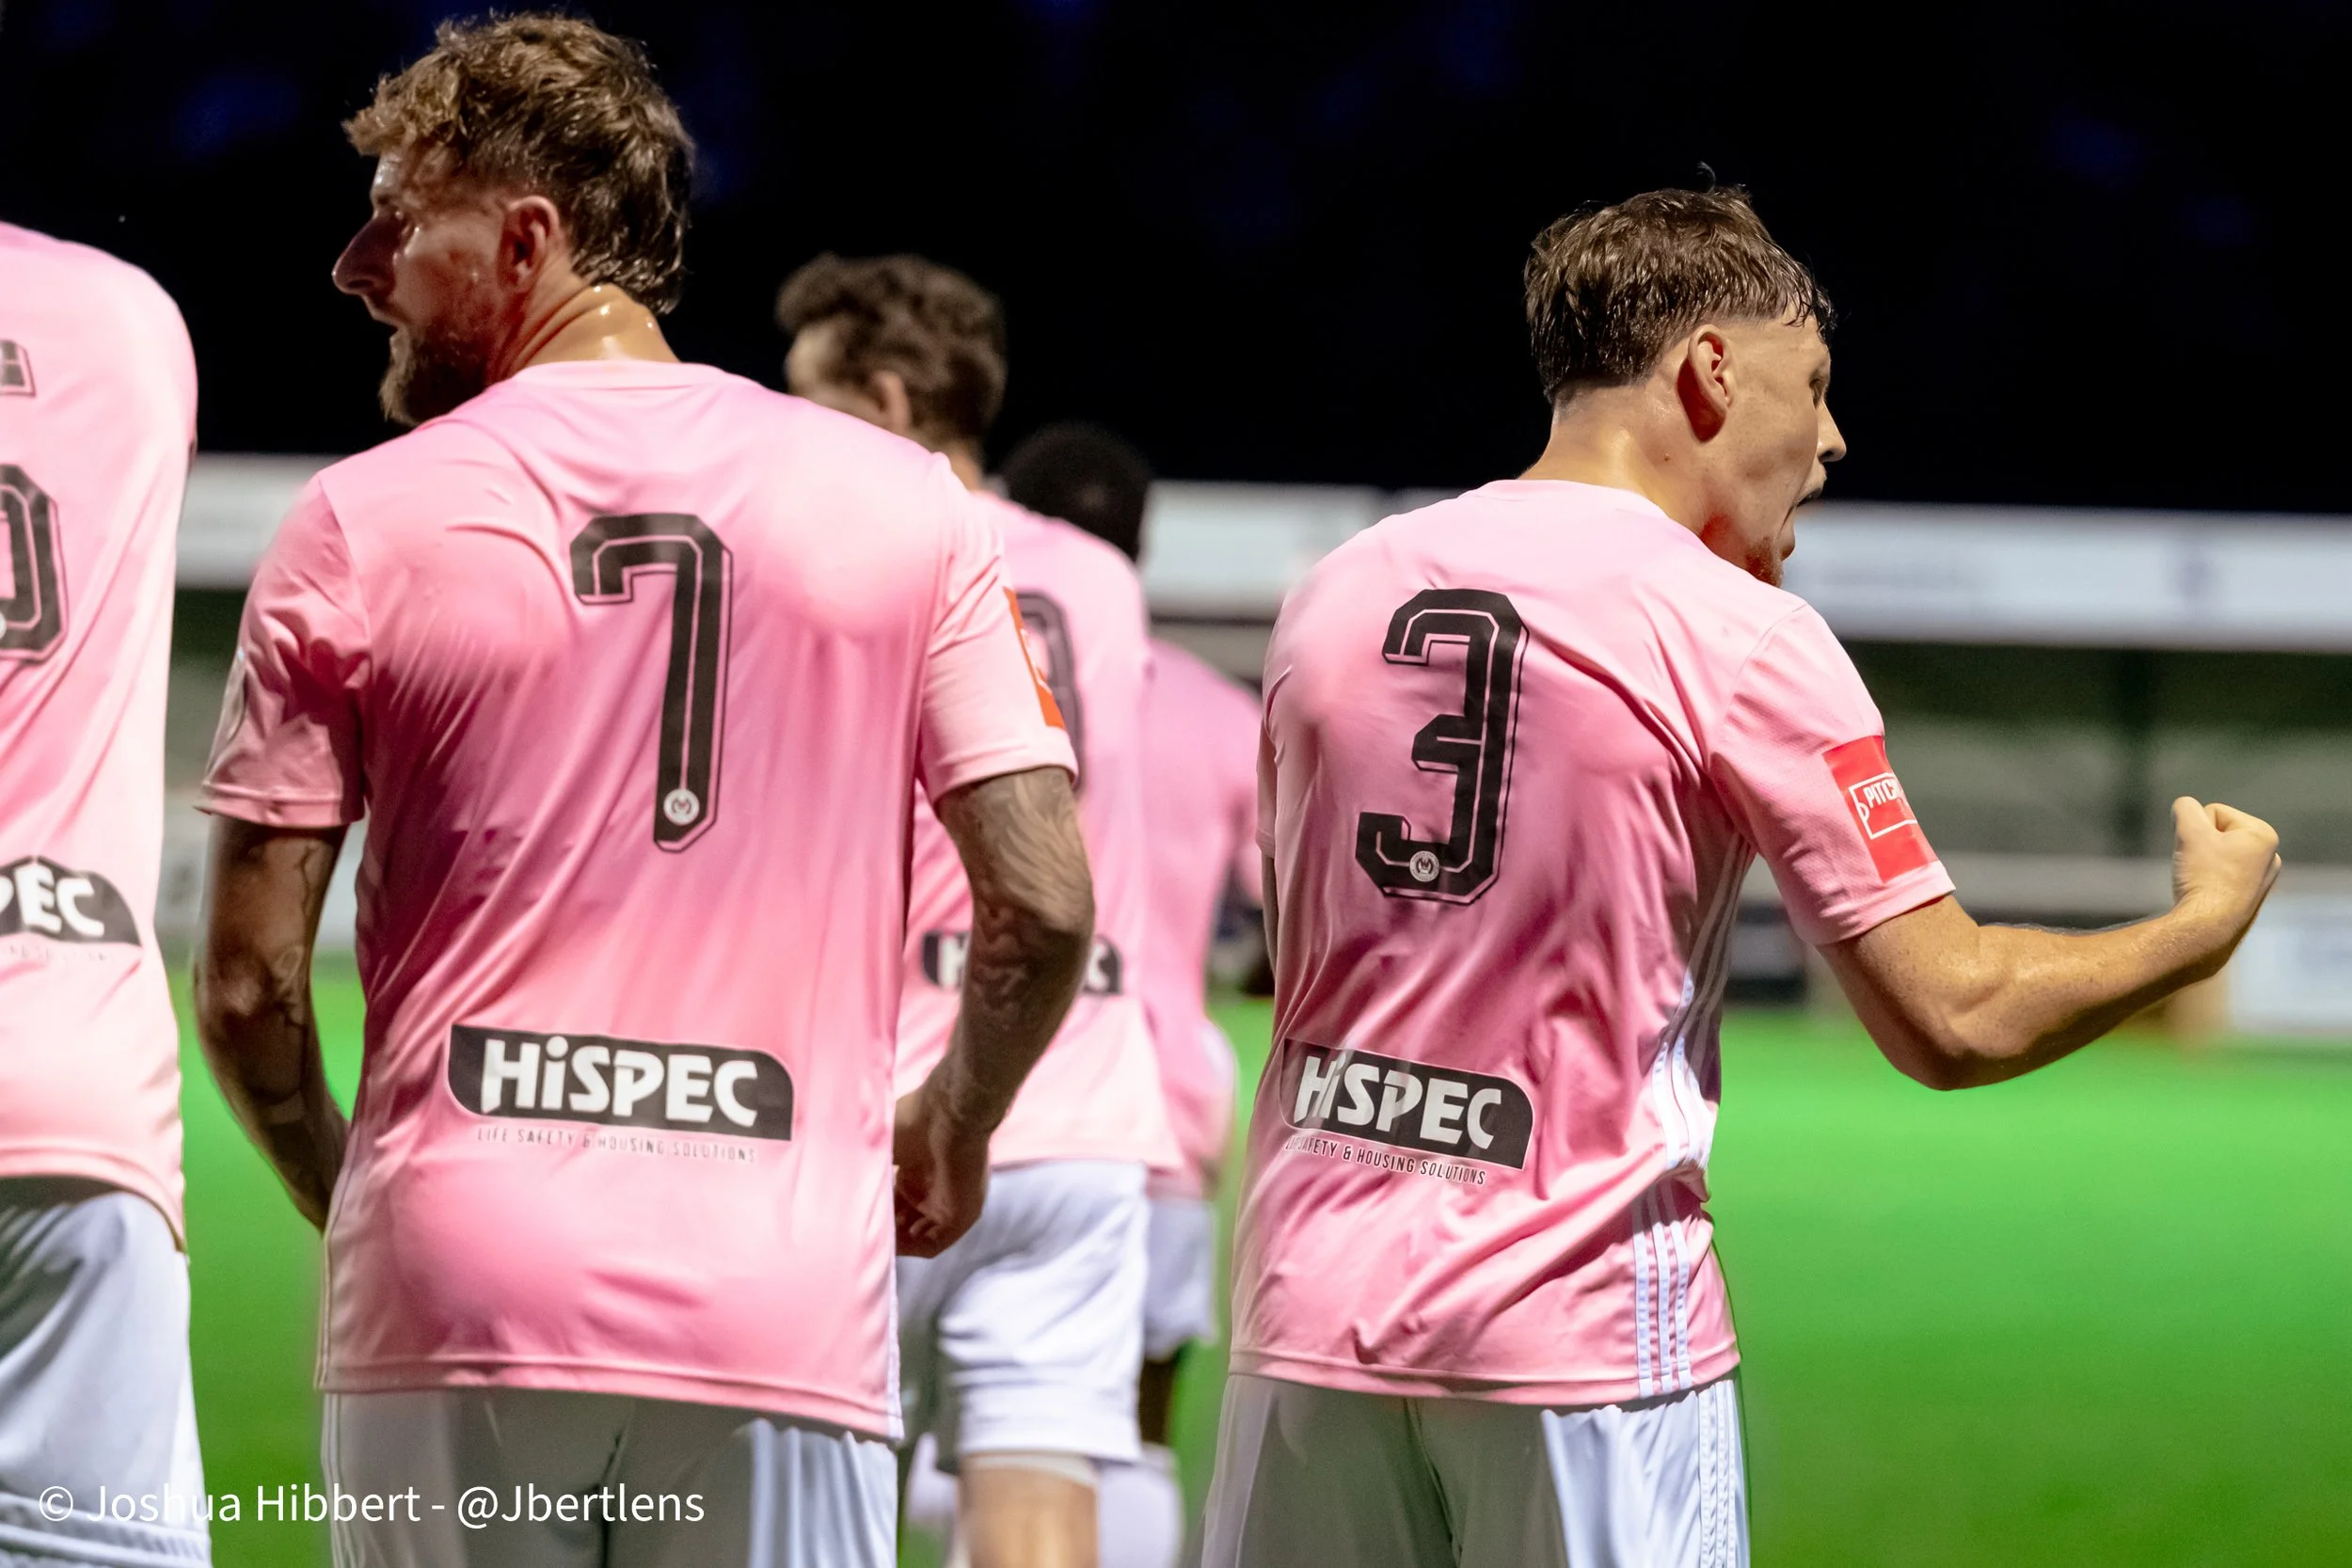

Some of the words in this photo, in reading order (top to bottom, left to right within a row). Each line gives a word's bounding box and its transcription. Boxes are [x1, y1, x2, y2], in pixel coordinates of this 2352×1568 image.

[569, 513, 733, 853] 7
[1355, 588, 1530, 906] 3
[517, 1128, 575, 1147] SAFETY
[597, 1135, 665, 1156] HOUSING
[673, 1141, 756, 1164] SOLUTIONS
[1343, 1146, 1352, 1161] &
[1357, 1148, 1415, 1173] HOUSING
[1420, 1161, 1486, 1185] SOLUTIONS
